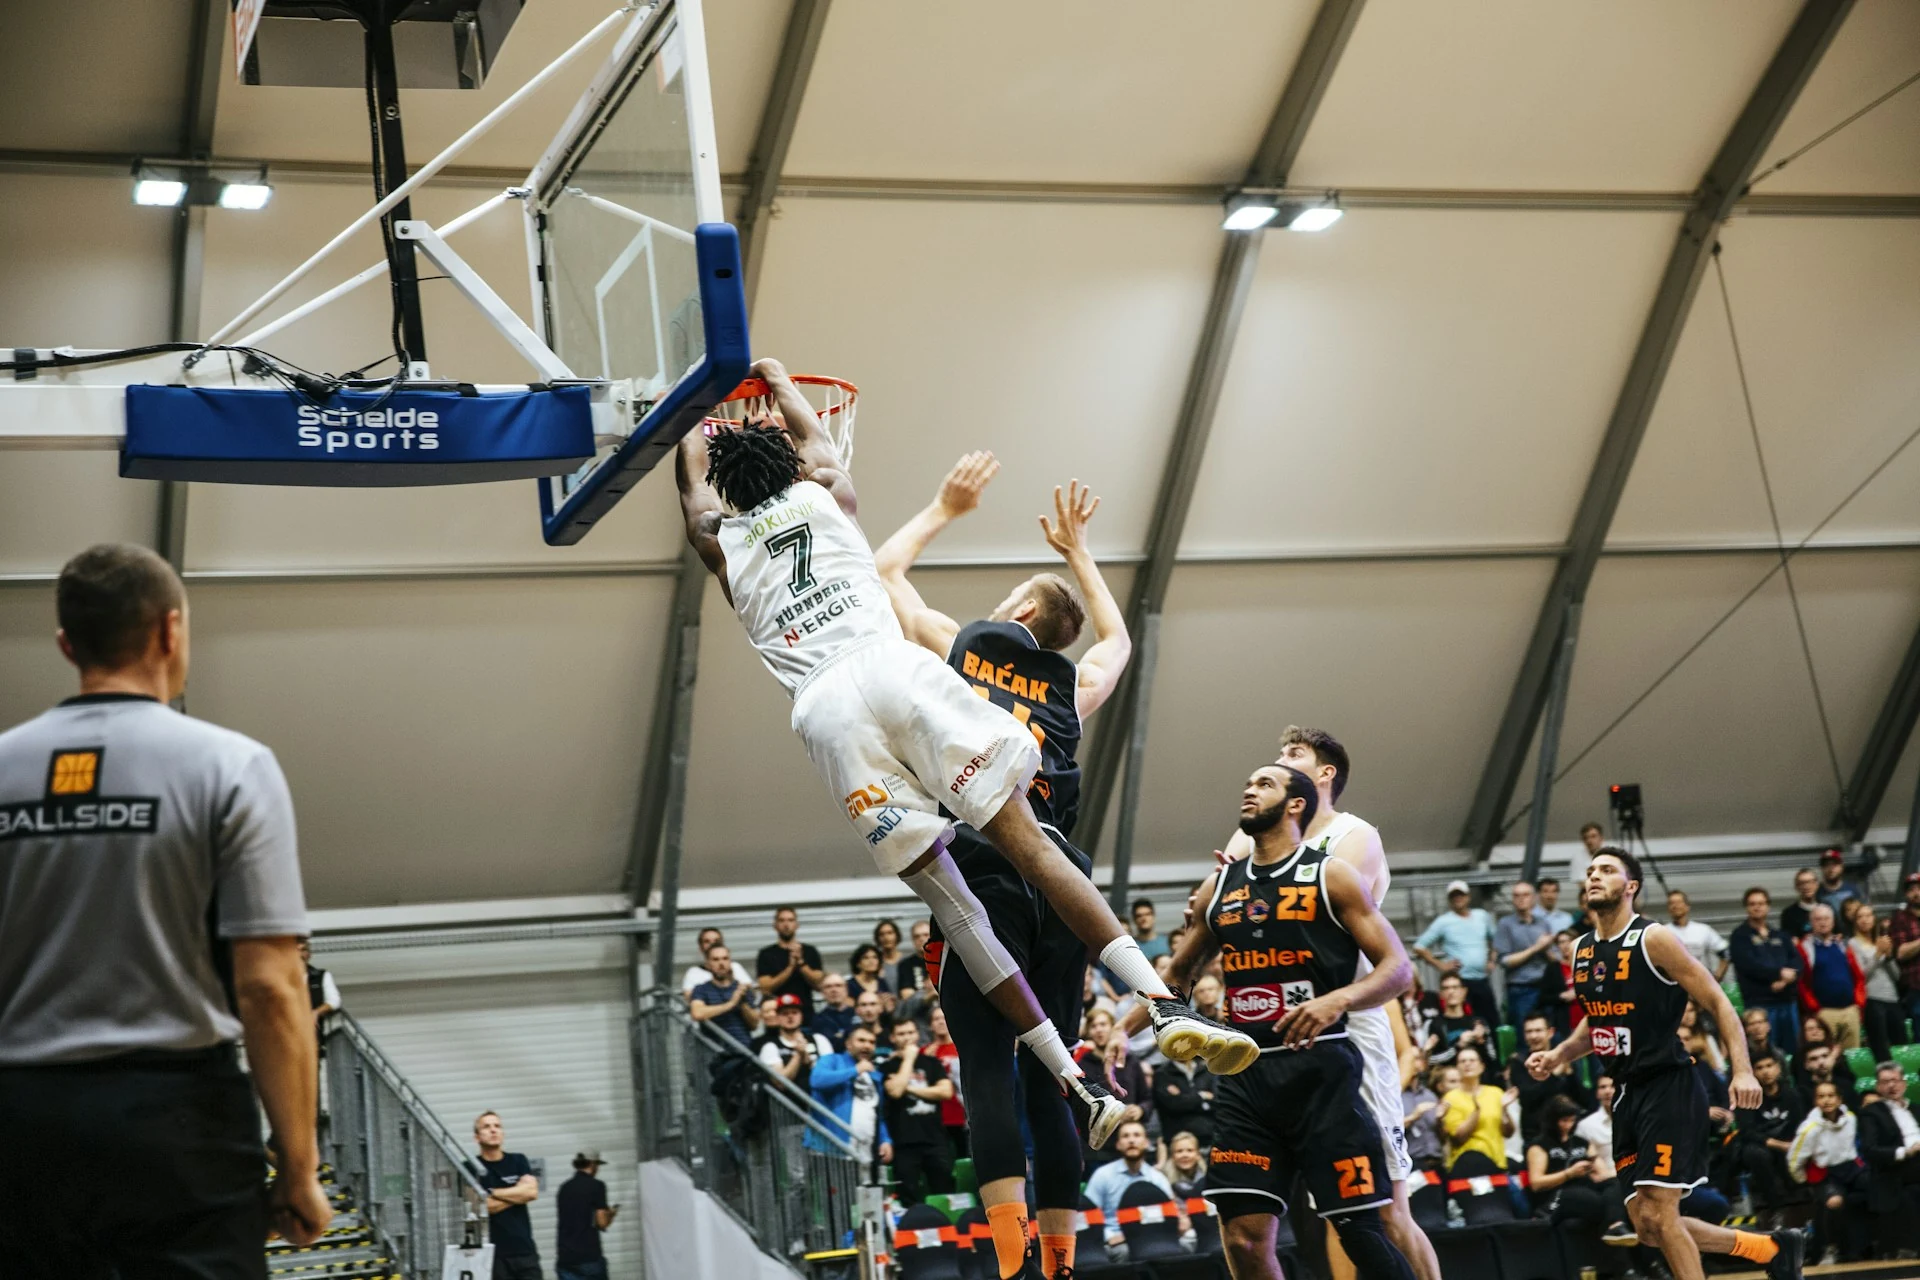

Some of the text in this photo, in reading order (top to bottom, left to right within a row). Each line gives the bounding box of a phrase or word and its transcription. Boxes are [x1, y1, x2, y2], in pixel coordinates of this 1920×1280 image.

[297, 405, 439, 428] Schelde
[297, 426, 439, 453] Sports
[764, 522, 818, 599] 7
[962, 650, 1049, 704] BAĆAK
[0, 803, 152, 835] BALLSIDE
[1276, 885, 1318, 922] 23
[1615, 950, 1632, 980] 3
[1231, 994, 1280, 1012] Helios
[1585, 1000, 1635, 1017] übler
[1654, 1144, 1673, 1177] 3
[1333, 1155, 1376, 1200] 23
